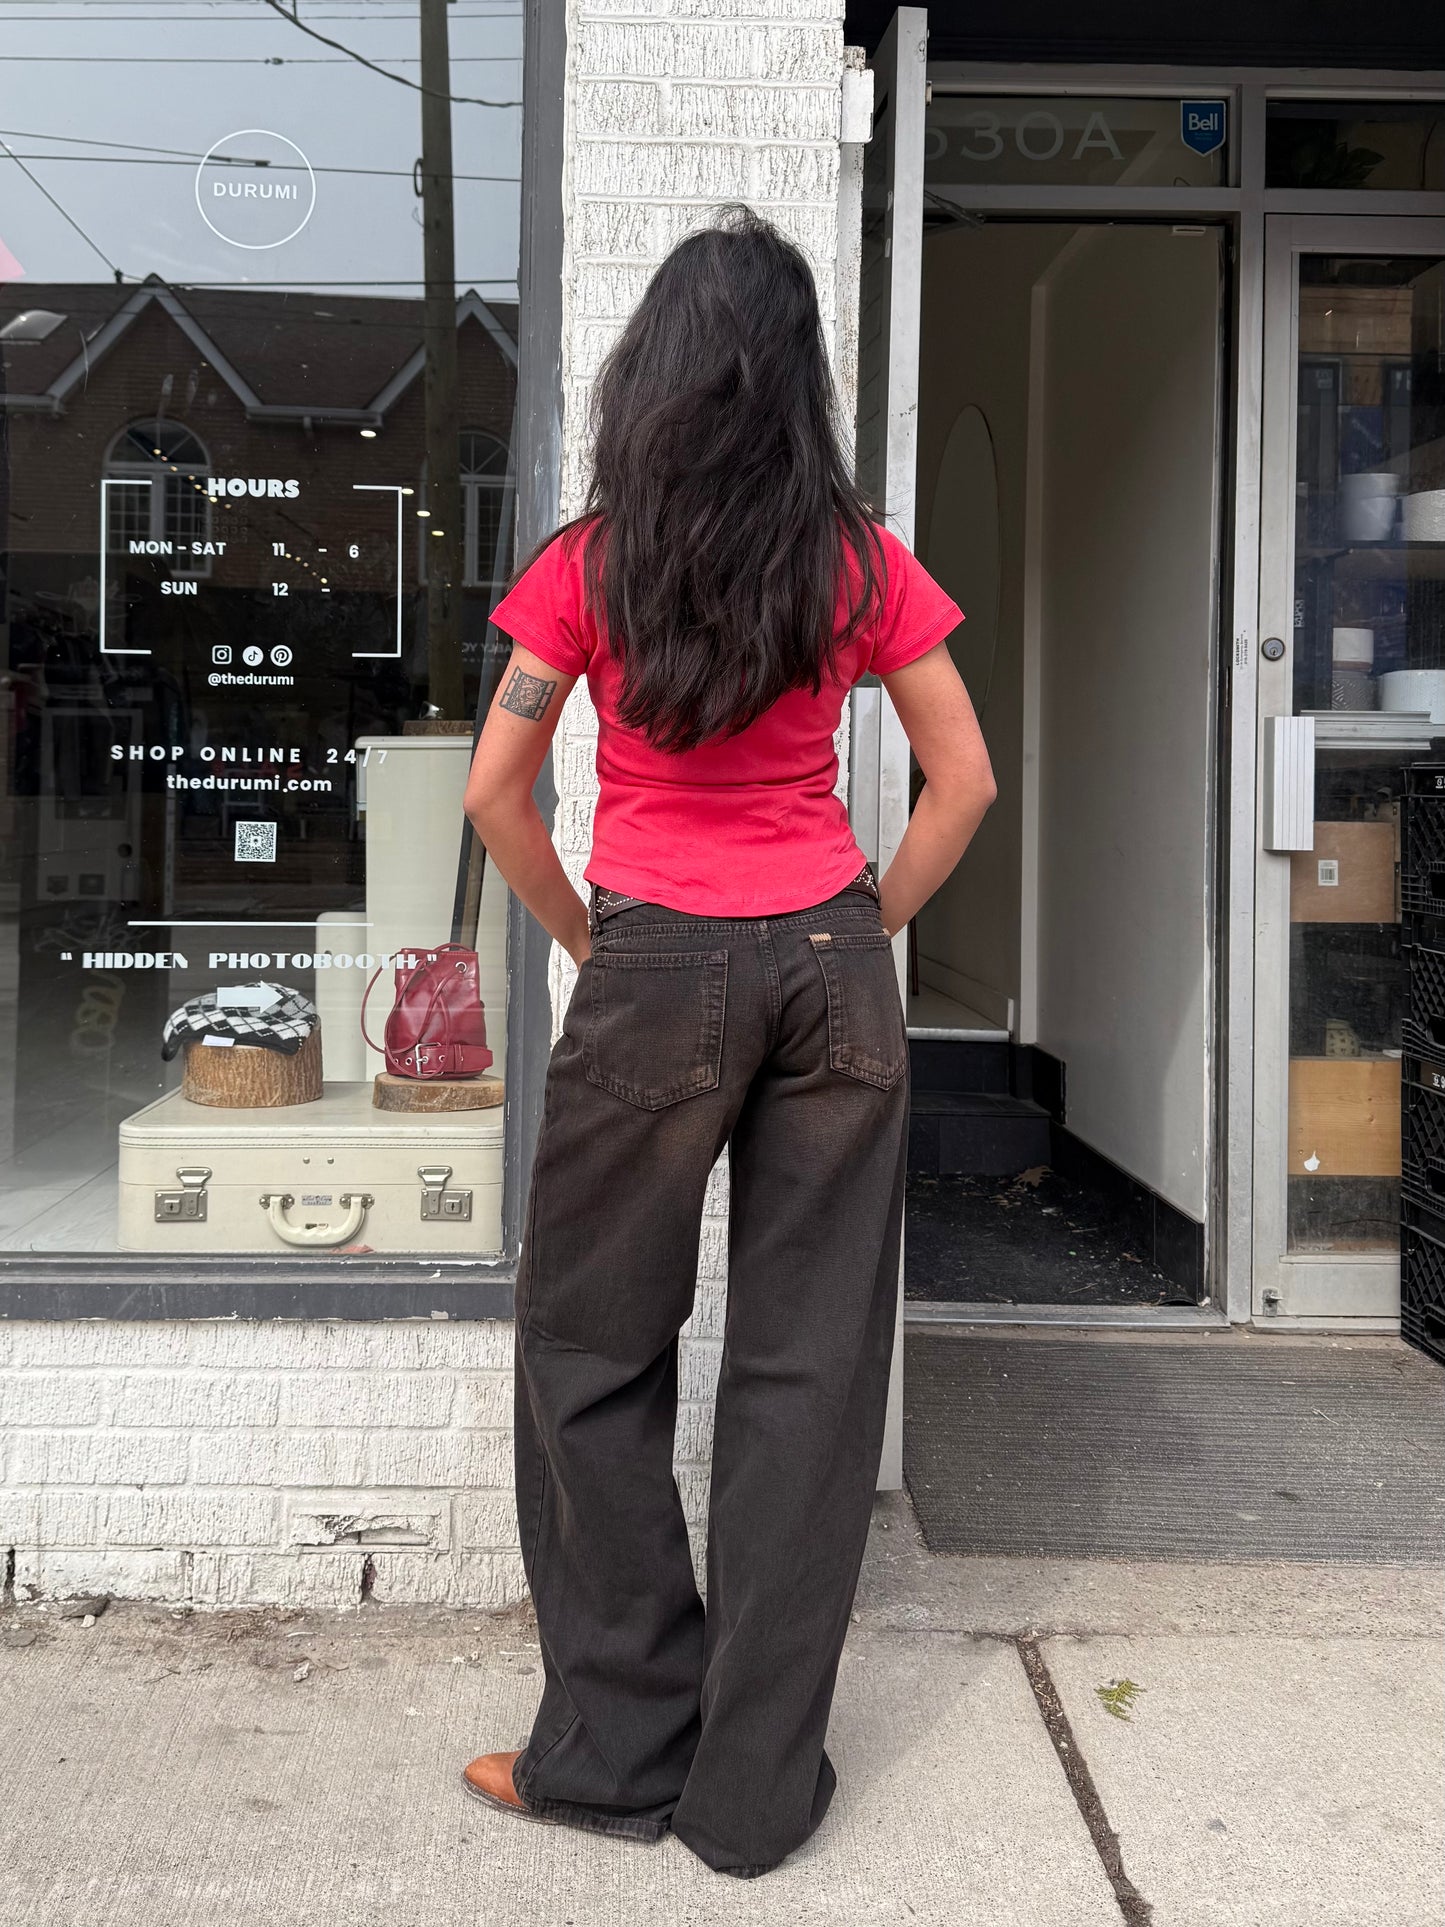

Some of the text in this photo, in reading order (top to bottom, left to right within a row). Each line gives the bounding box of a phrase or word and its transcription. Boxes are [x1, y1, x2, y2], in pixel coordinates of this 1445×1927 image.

[1188, 112, 1219, 131] Bell
[213, 182, 299, 200] DURUMI
[207, 477, 301, 499] HOURS
[129, 540, 174, 555] MON
[191, 541, 228, 556] SAT
[349, 544, 360, 559] 6
[160, 581, 198, 596] SUN
[272, 582, 290, 597] 12
[208, 672, 295, 687] @thedurumi
[110, 744, 389, 768] SHOP ONLINE 24/7
[166, 774, 333, 793] thedurumi.com
